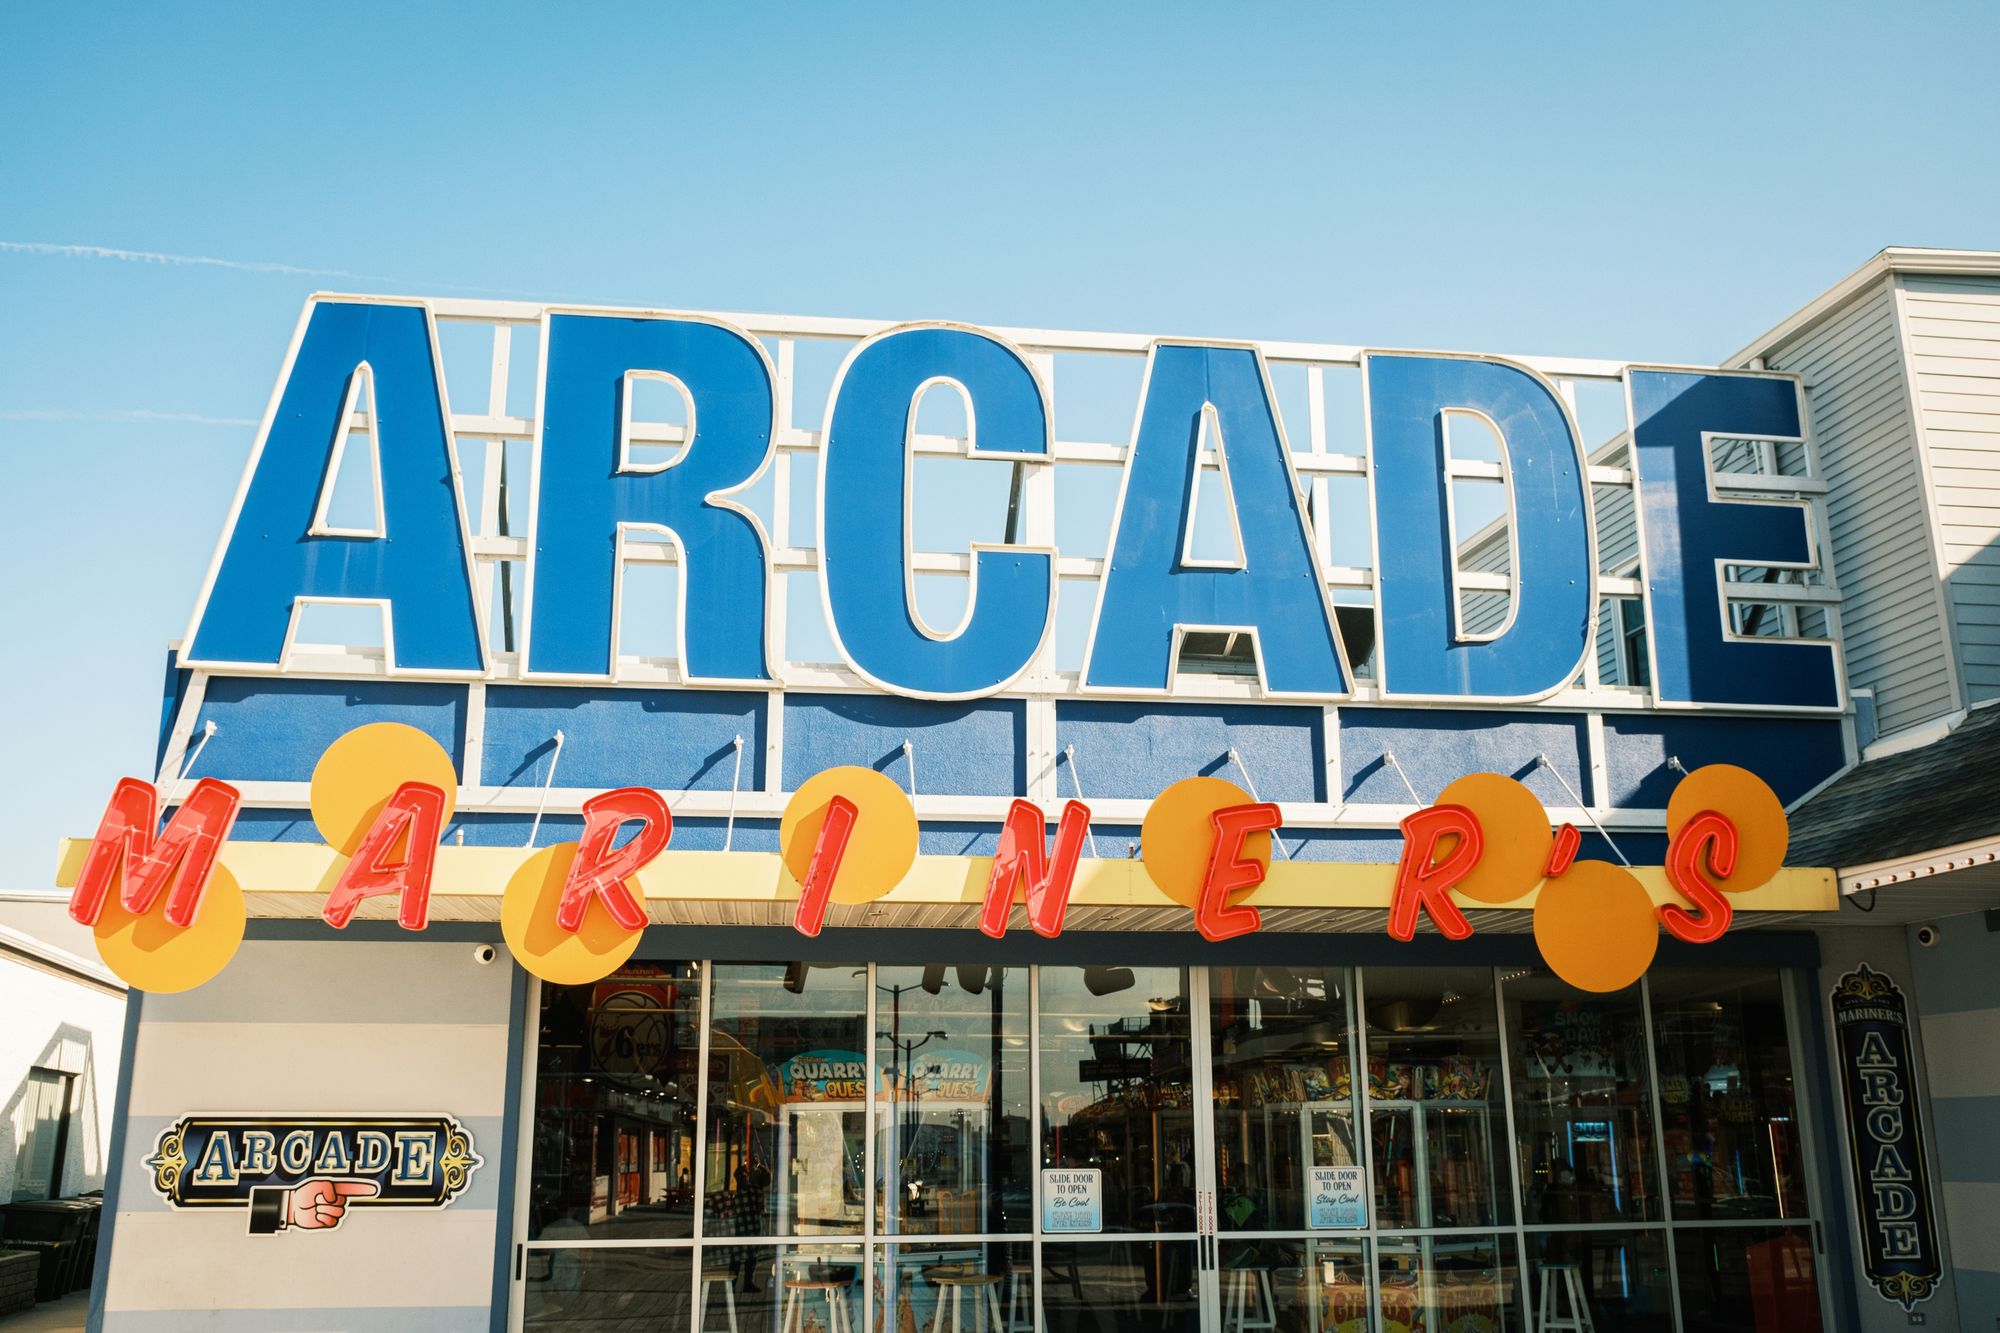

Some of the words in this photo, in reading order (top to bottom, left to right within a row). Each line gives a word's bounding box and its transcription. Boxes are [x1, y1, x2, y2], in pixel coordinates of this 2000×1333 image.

[175, 291, 1847, 713] ARCADE
[68, 776, 1739, 944] MARINER'S
[1838, 1008, 1904, 1024] MARINER'S
[825, 1081, 867, 1098] QUES
[936, 1081, 979, 1098] QUEST
[1857, 1032, 1921, 1259] ARCADE
[192, 1131, 437, 1186] ARCADE
[1049, 1174, 1071, 1184] SLIDE
[1073, 1174, 1094, 1184] DOOR
[1315, 1171, 1336, 1181] SLIDE
[1338, 1171, 1358, 1181] DOOR
[1056, 1185, 1066, 1194] TO
[1068, 1185, 1087, 1194] OPEN
[1322, 1181, 1331, 1191] TO
[1333, 1181, 1352, 1191] OPEN
[1053, 1197, 1067, 1207] Be
[1068, 1197, 1091, 1207] Cool
[1316, 1194, 1337, 1206] Stay
[1338, 1194, 1360, 1205] Cool
[1333, 1292, 1411, 1326] CIUS
